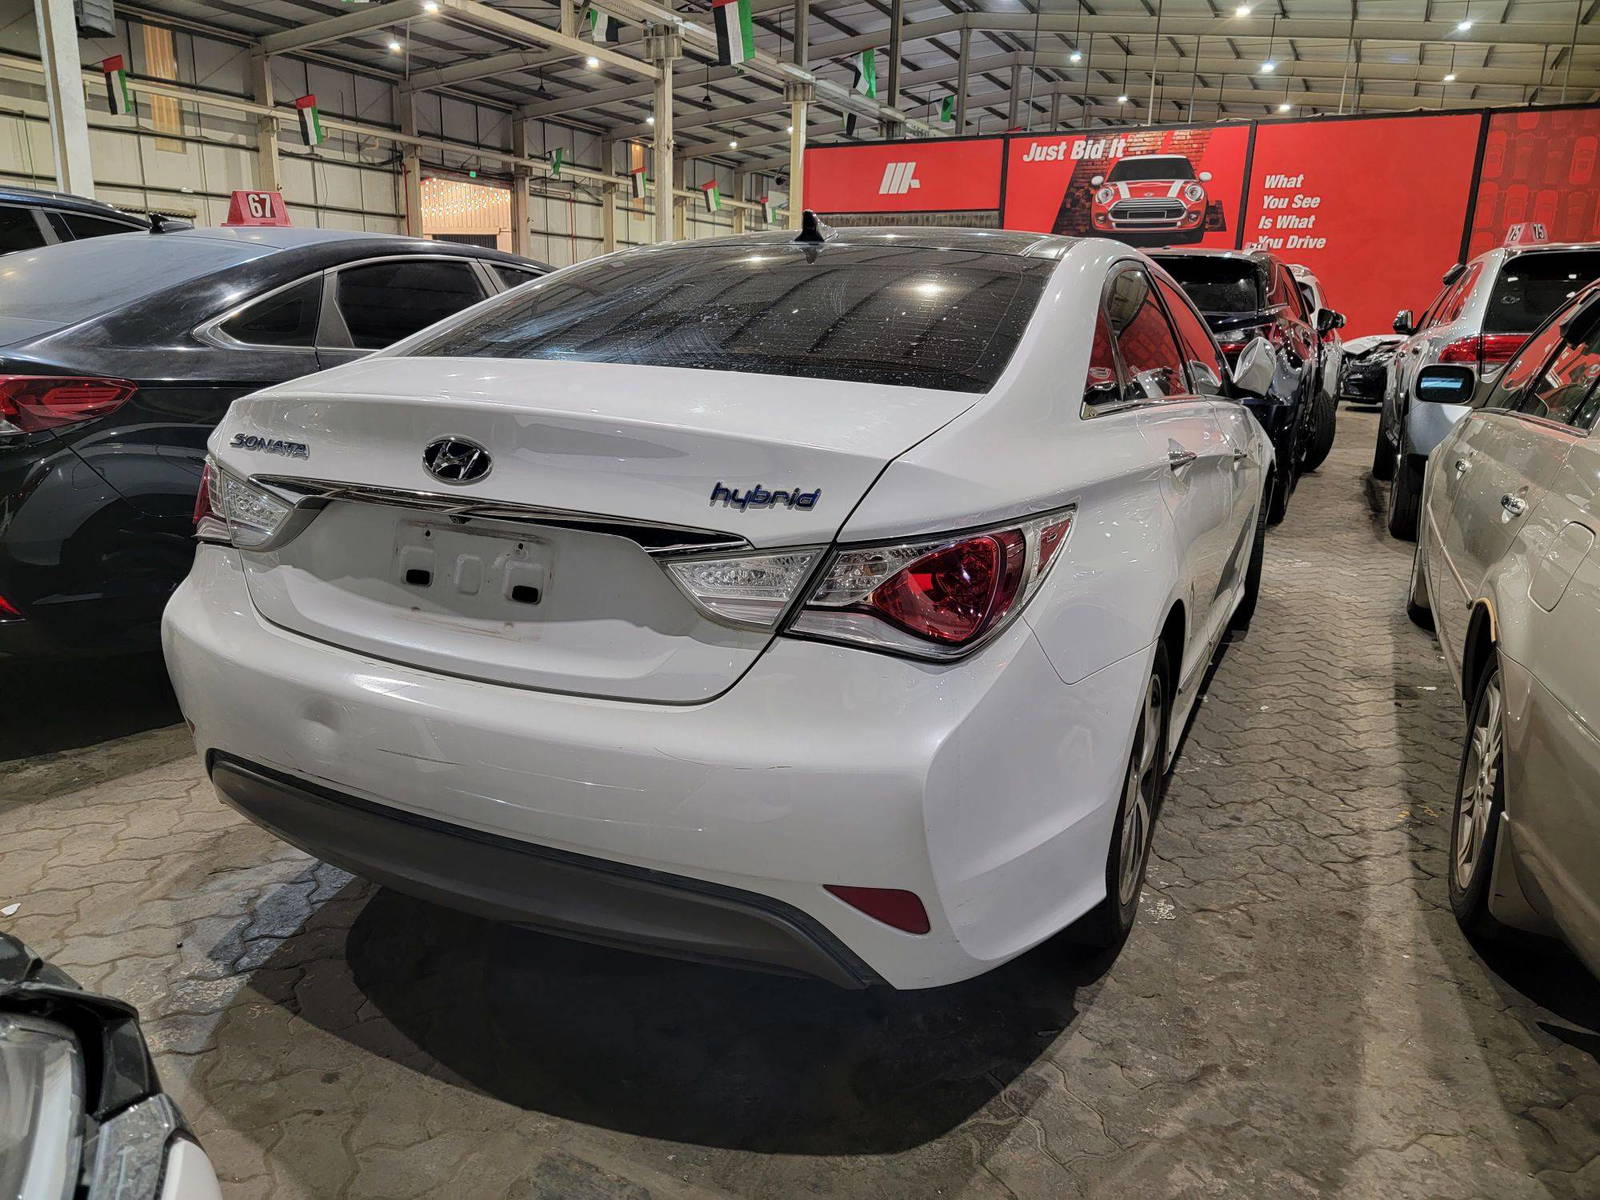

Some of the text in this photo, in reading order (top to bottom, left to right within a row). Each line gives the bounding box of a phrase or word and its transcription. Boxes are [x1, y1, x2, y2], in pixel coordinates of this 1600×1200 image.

[1022, 138, 1127, 162] Just Bid It
[1264, 174, 1305, 189] What
[247, 193, 272, 218] 67
[1262, 194, 1321, 209] You See
[1258, 214, 1316, 229] Is What
[1286, 235, 1327, 249] Drive
[230, 433, 310, 460] SONATA
[709, 482, 822, 513] hybrid
